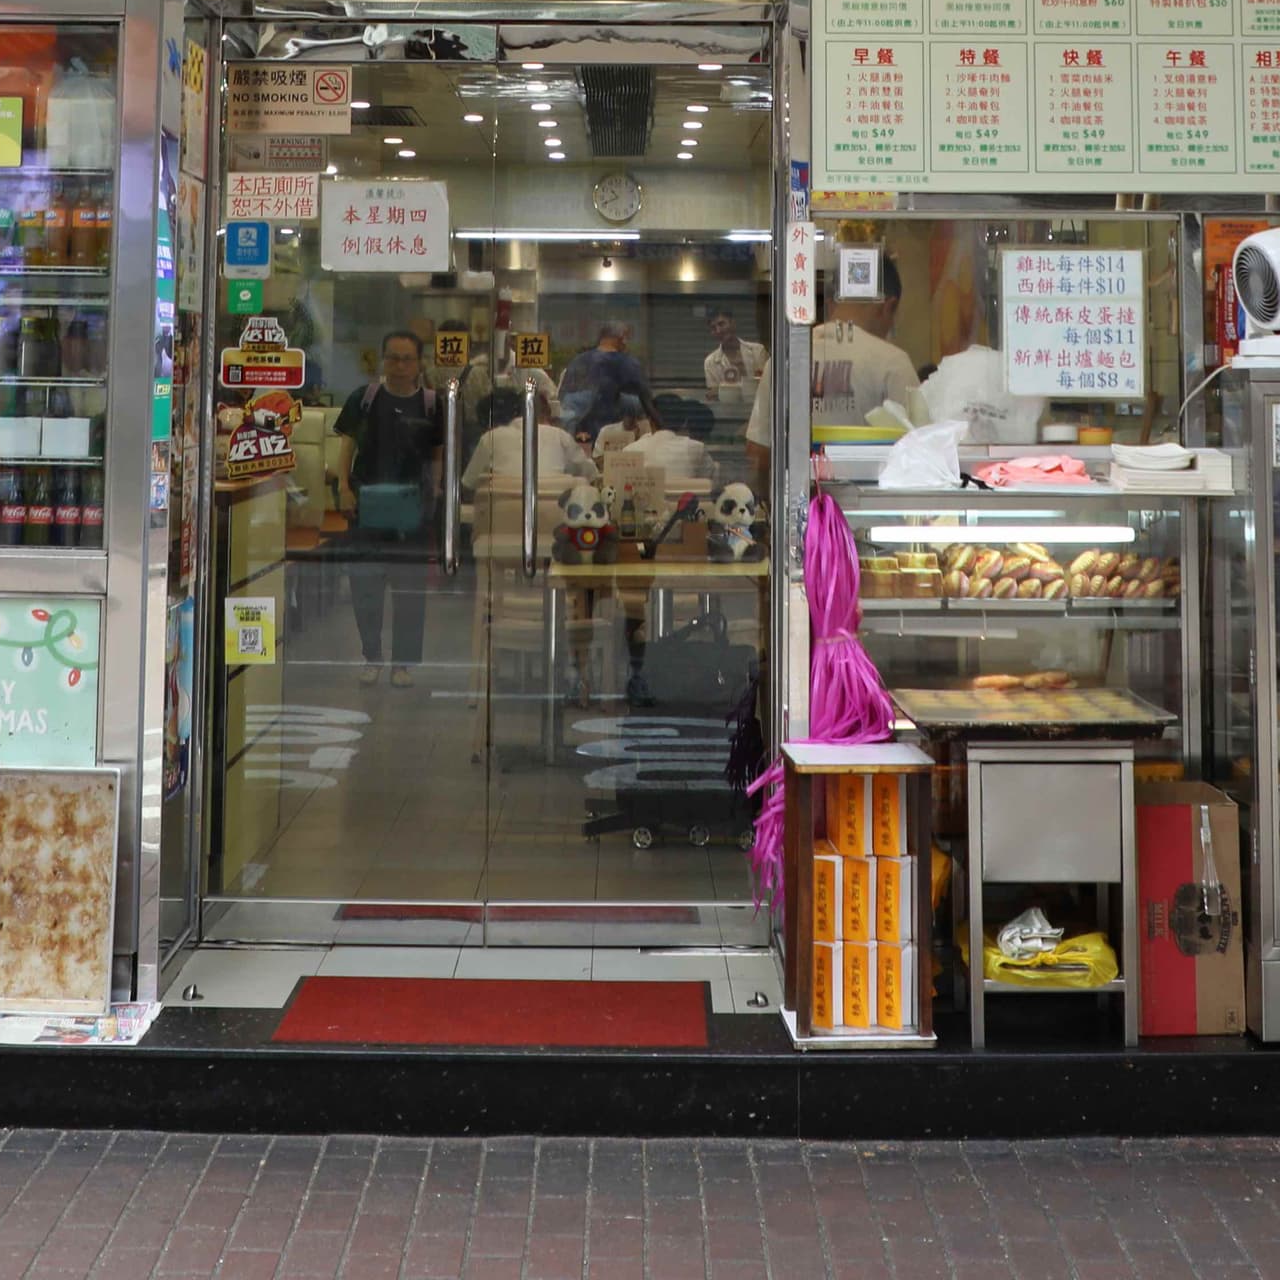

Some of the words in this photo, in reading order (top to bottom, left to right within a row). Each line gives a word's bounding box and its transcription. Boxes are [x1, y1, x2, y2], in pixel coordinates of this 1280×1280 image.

[853, 47, 894, 65] 早餐
[959, 48, 1000, 66] 特餐
[1062, 48, 1103, 66] 快餐
[1165, 49, 1207, 67] 午餐
[232, 68, 308, 87] 嚴禁吸煙
[232, 93, 250, 103] NO
[253, 92, 309, 103] SMOKING
[872, 128, 895, 139] $49
[231, 175, 314, 197] 本店廁所
[231, 197, 314, 218] 恕不外借
[342, 205, 428, 226] 本星期四
[341, 234, 428, 257] 例假休息
[792, 226, 809, 320] 外賣請進
[439, 336, 464, 356] 拉
[521, 337, 545, 356] 拉
[521, 356, 544, 365] PULL
